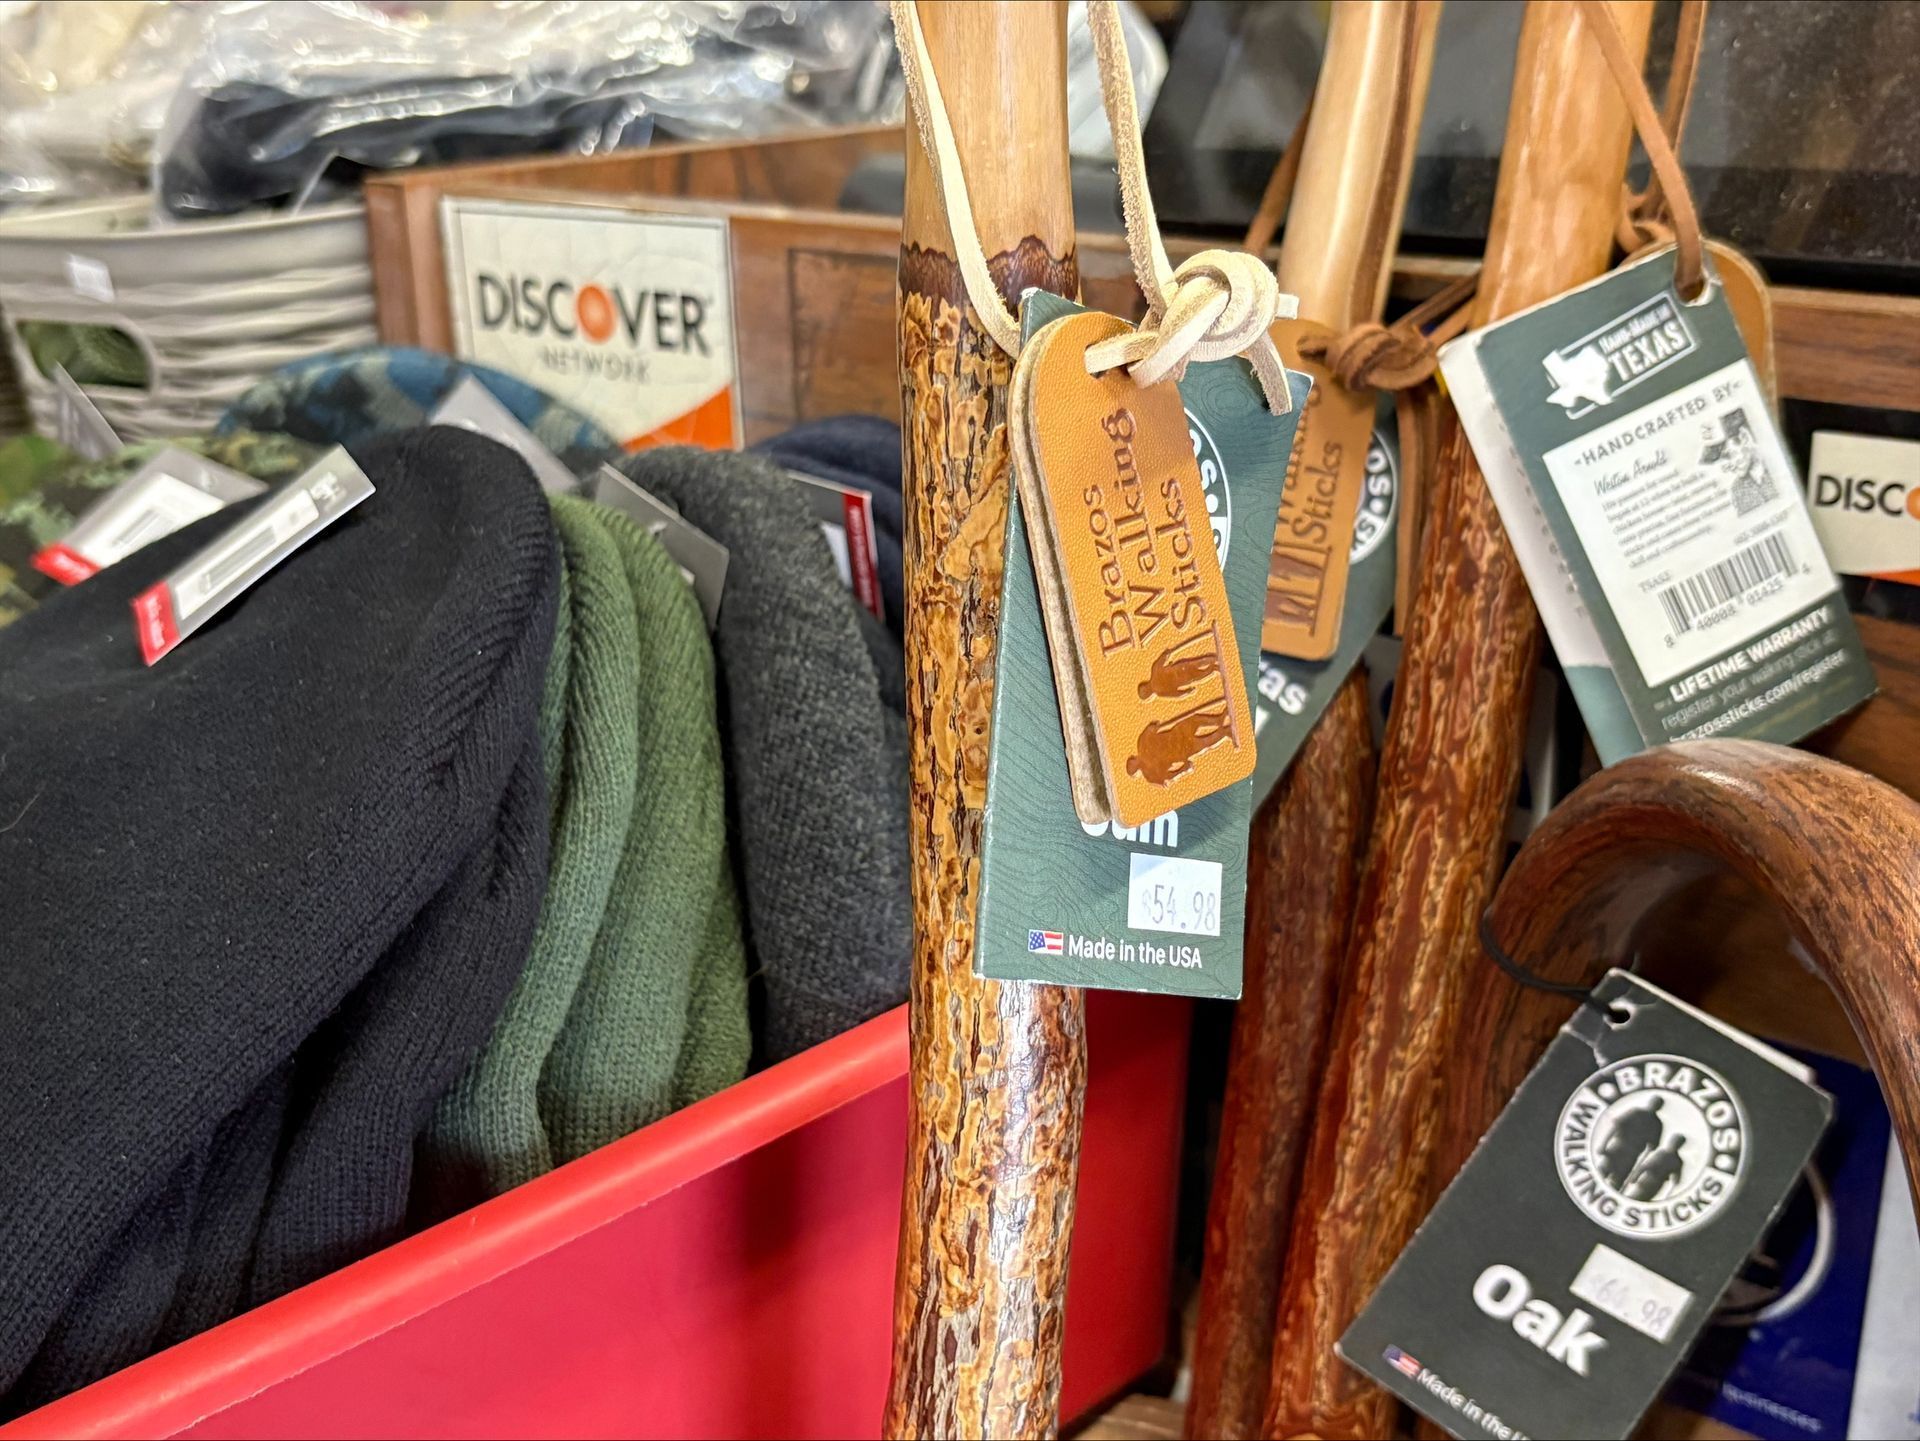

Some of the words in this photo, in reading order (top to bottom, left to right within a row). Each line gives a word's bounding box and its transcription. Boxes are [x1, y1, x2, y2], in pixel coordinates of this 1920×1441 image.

[476, 273, 712, 357] DISCOVER
[1607, 319, 1686, 381] TEXAS
[542, 346, 650, 383] NETWORK
[1581, 397, 1706, 465] HANDCRAFTED
[1712, 381, 1733, 402] BY
[1101, 408, 1171, 649] Walking
[1292, 440, 1342, 543] Sticks
[1084, 484, 1135, 659] Brazos
[1155, 477, 1208, 631] Sticks
[1669, 651, 1748, 702] LIFETIME
[1746, 604, 1832, 663] WARRANTY
[1661, 696, 1715, 731] register
[1717, 678, 1750, 704] your
[1069, 935, 1115, 960] Made
[1120, 939, 1135, 963] in
[1139, 942, 1166, 965] the
[1169, 945, 1203, 969] USA
[1614, 1062, 1739, 1152] BRAZOS
[1563, 1099, 1619, 1217] WALKING
[1622, 1176, 1723, 1228] STICKS
[1473, 1264, 1609, 1377] Oak
[1416, 1368, 1464, 1409] Made
[1462, 1399, 1484, 1421] in
[1481, 1411, 1514, 1440] the
